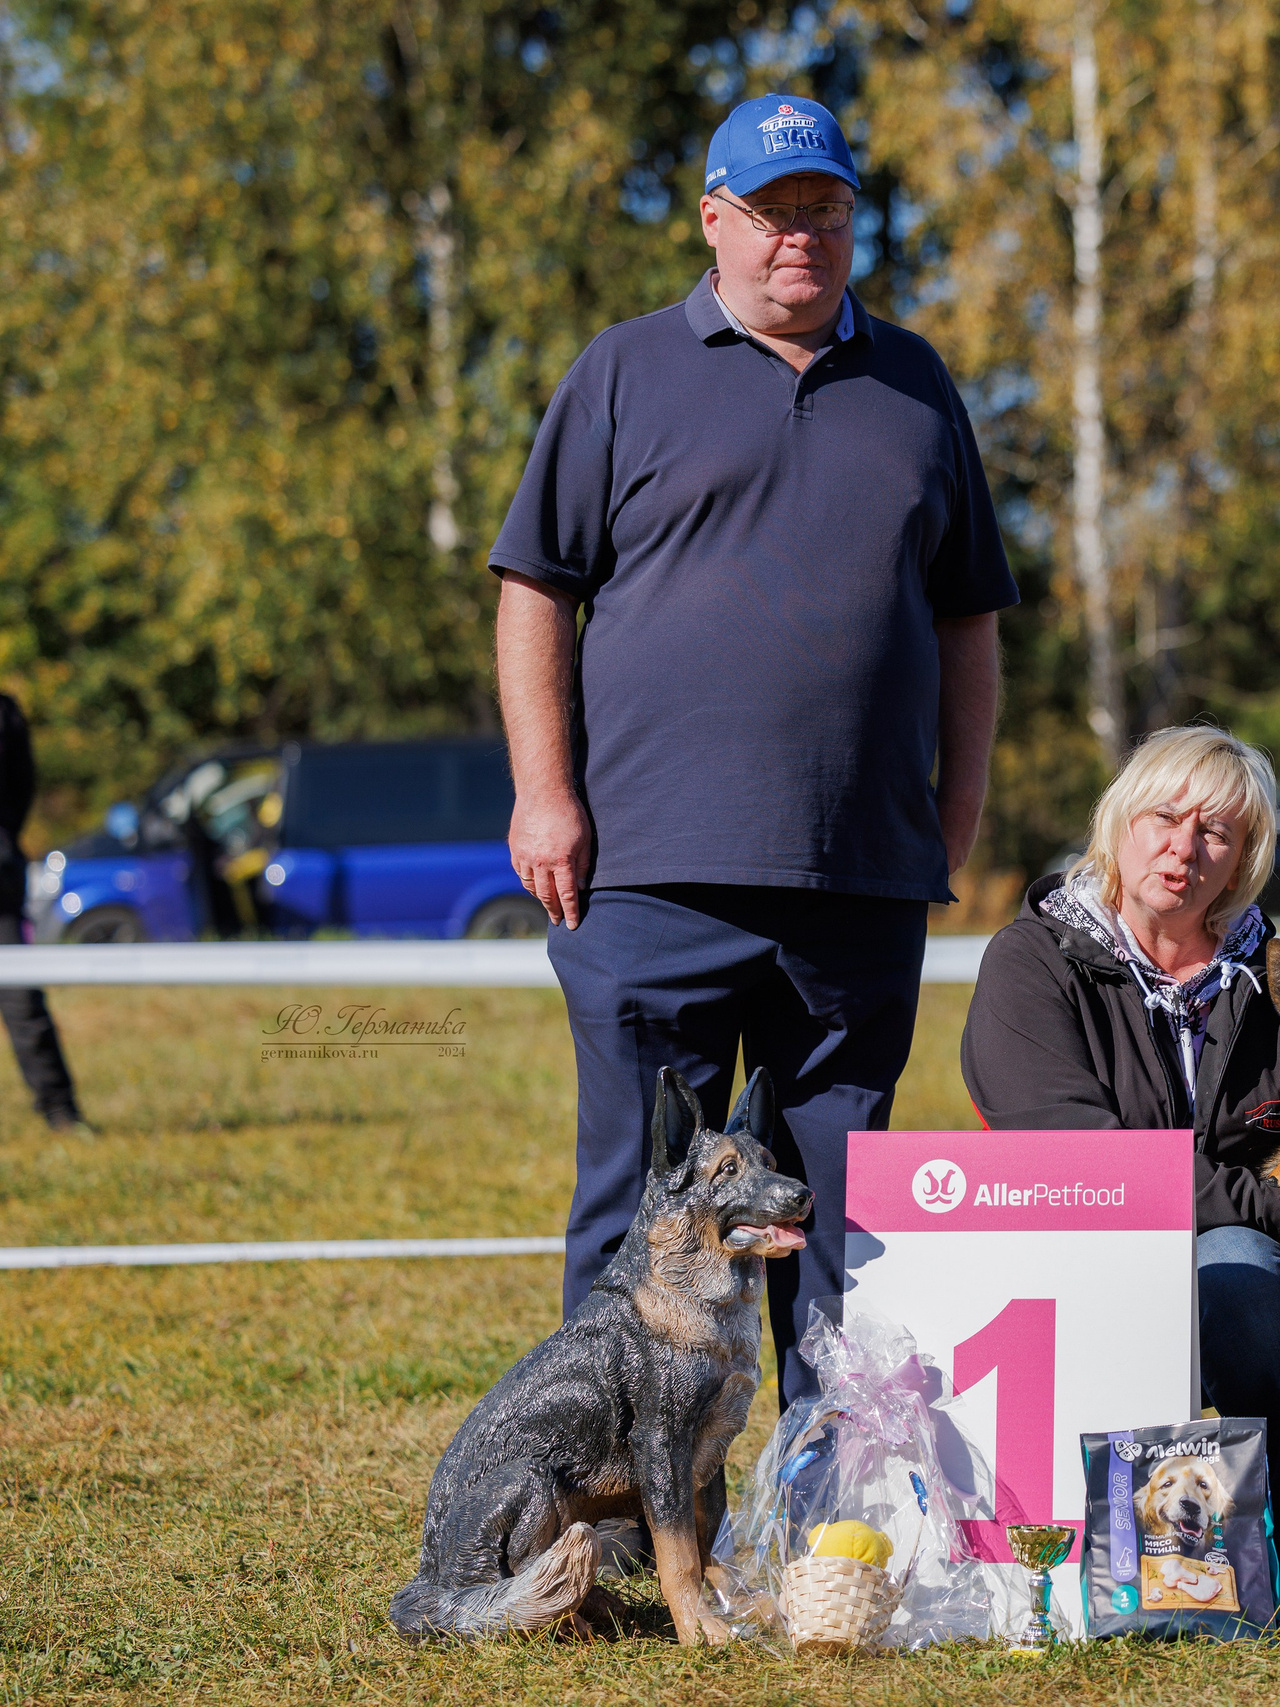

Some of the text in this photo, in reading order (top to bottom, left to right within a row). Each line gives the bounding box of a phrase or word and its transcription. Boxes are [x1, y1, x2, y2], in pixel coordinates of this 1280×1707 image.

[763, 130, 826, 155] 1946
[973, 1183, 1125, 1207] AllerPetfood
[950, 1299, 1085, 1564] 1
[1145, 1438, 1220, 1460] Melwin
[1196, 1454, 1220, 1465] dogs
[1113, 1472, 1131, 1531] SENIOR
[1145, 1539, 1172, 1548] МЯСО
[1145, 1545, 1181, 1554] ПТИЦЫ
[1121, 1591, 1129, 1602] 1
